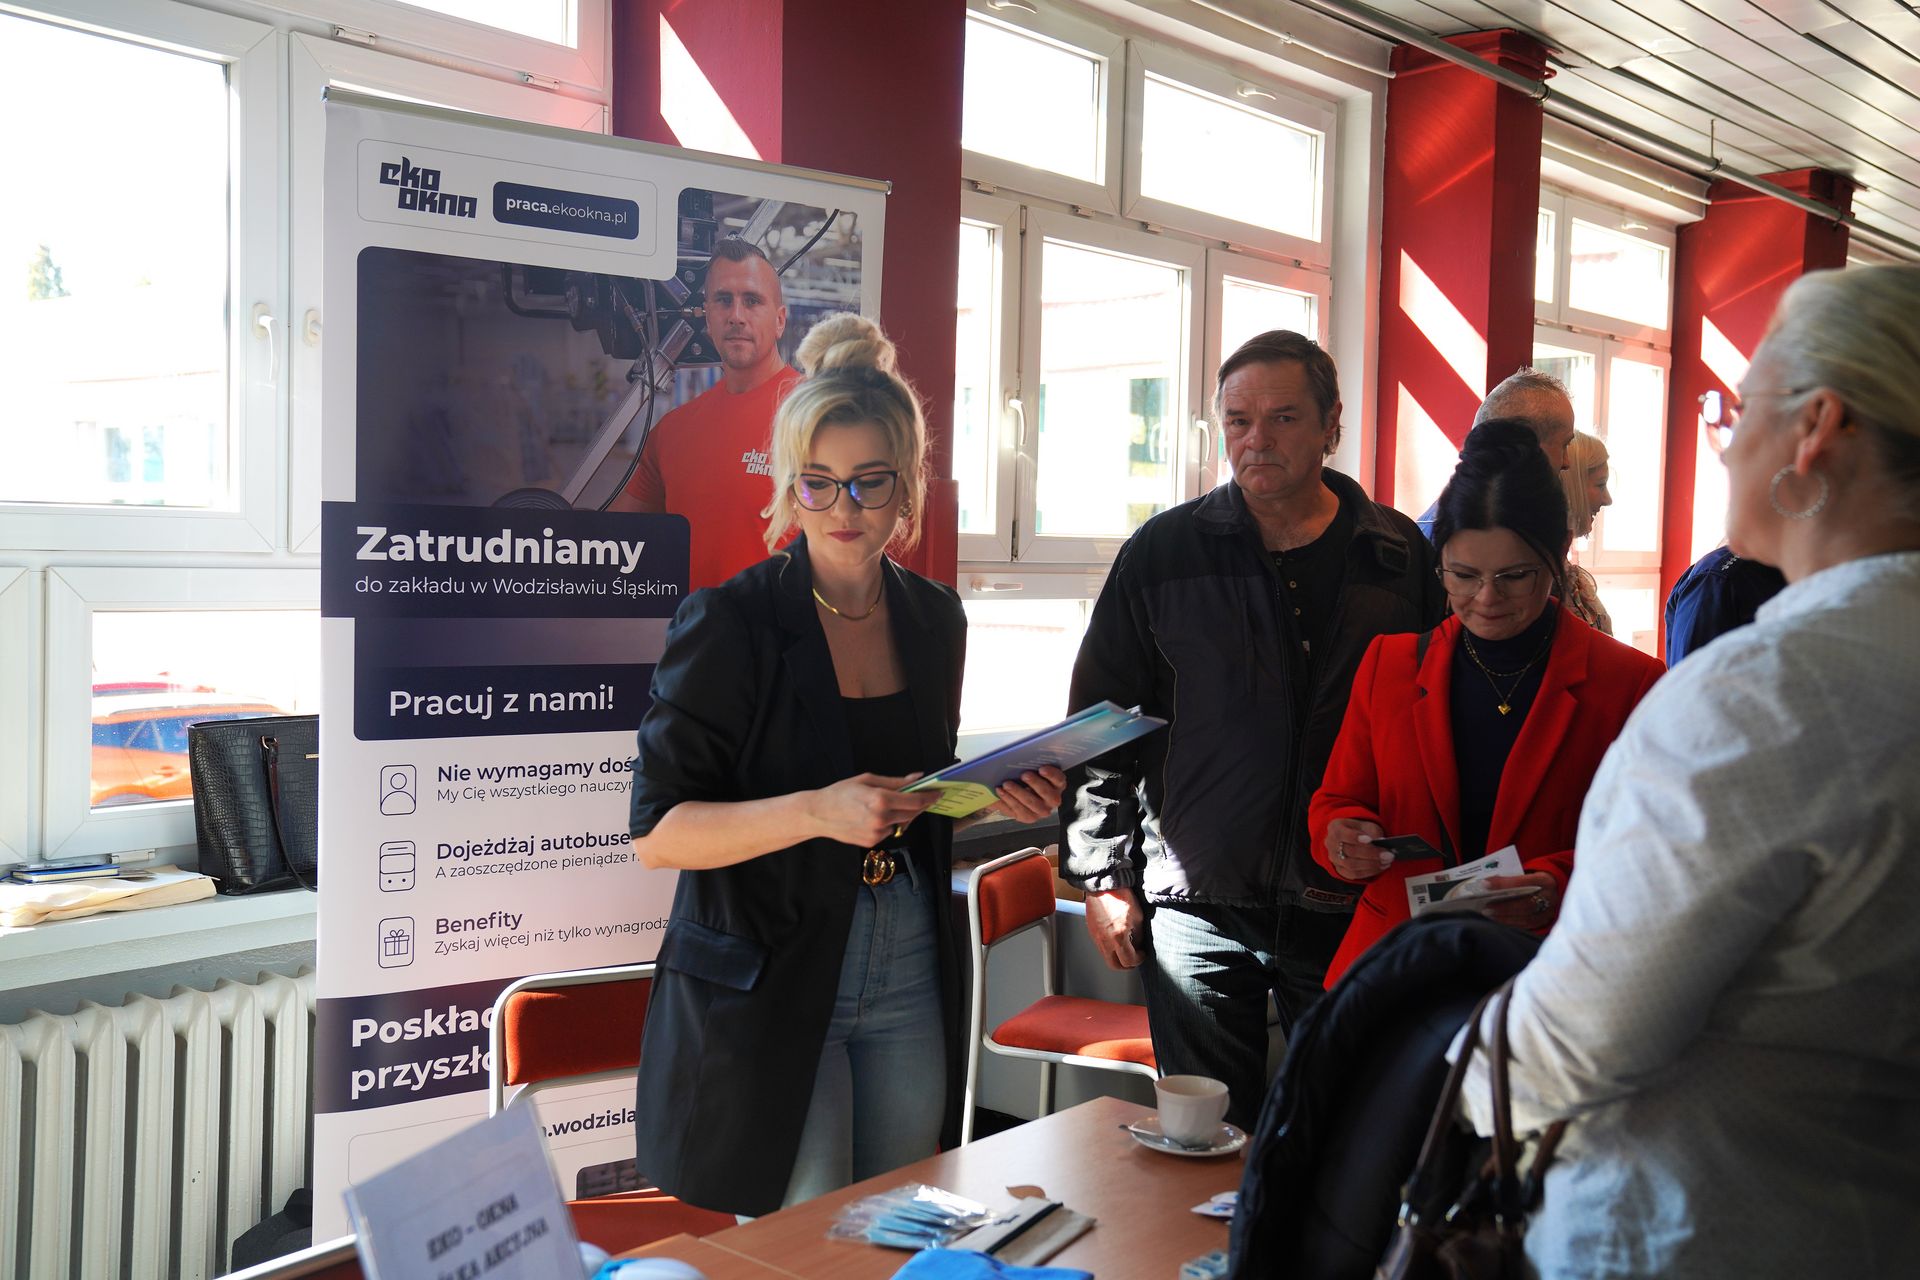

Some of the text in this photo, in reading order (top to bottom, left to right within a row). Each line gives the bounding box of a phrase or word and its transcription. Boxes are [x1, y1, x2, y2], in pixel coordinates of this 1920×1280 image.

[506, 196, 627, 225] praca.ekookna.pl
[745, 463, 776, 477] okn
[356, 526, 645, 574] Zatrudniamy
[355, 575, 678, 600] do zakładu w Wodzisławiu Śląskim
[390, 683, 614, 720] Pracuj z nami!
[438, 764, 472, 783] Nie
[476, 761, 594, 783] wymagamy
[437, 789, 459, 804] My
[462, 786, 486, 802] Cię
[489, 782, 576, 799] wszystkiego
[437, 836, 535, 862] Dojeżdżaj
[435, 866, 447, 879] A
[450, 858, 558, 878] zaoszczędzone
[561, 851, 628, 869] pieniądze
[435, 910, 523, 935] Benefity
[434, 936, 480, 955] Zyskaj
[484, 930, 530, 949] więcej
[534, 928, 555, 942] niż
[558, 925, 592, 943] tylko
